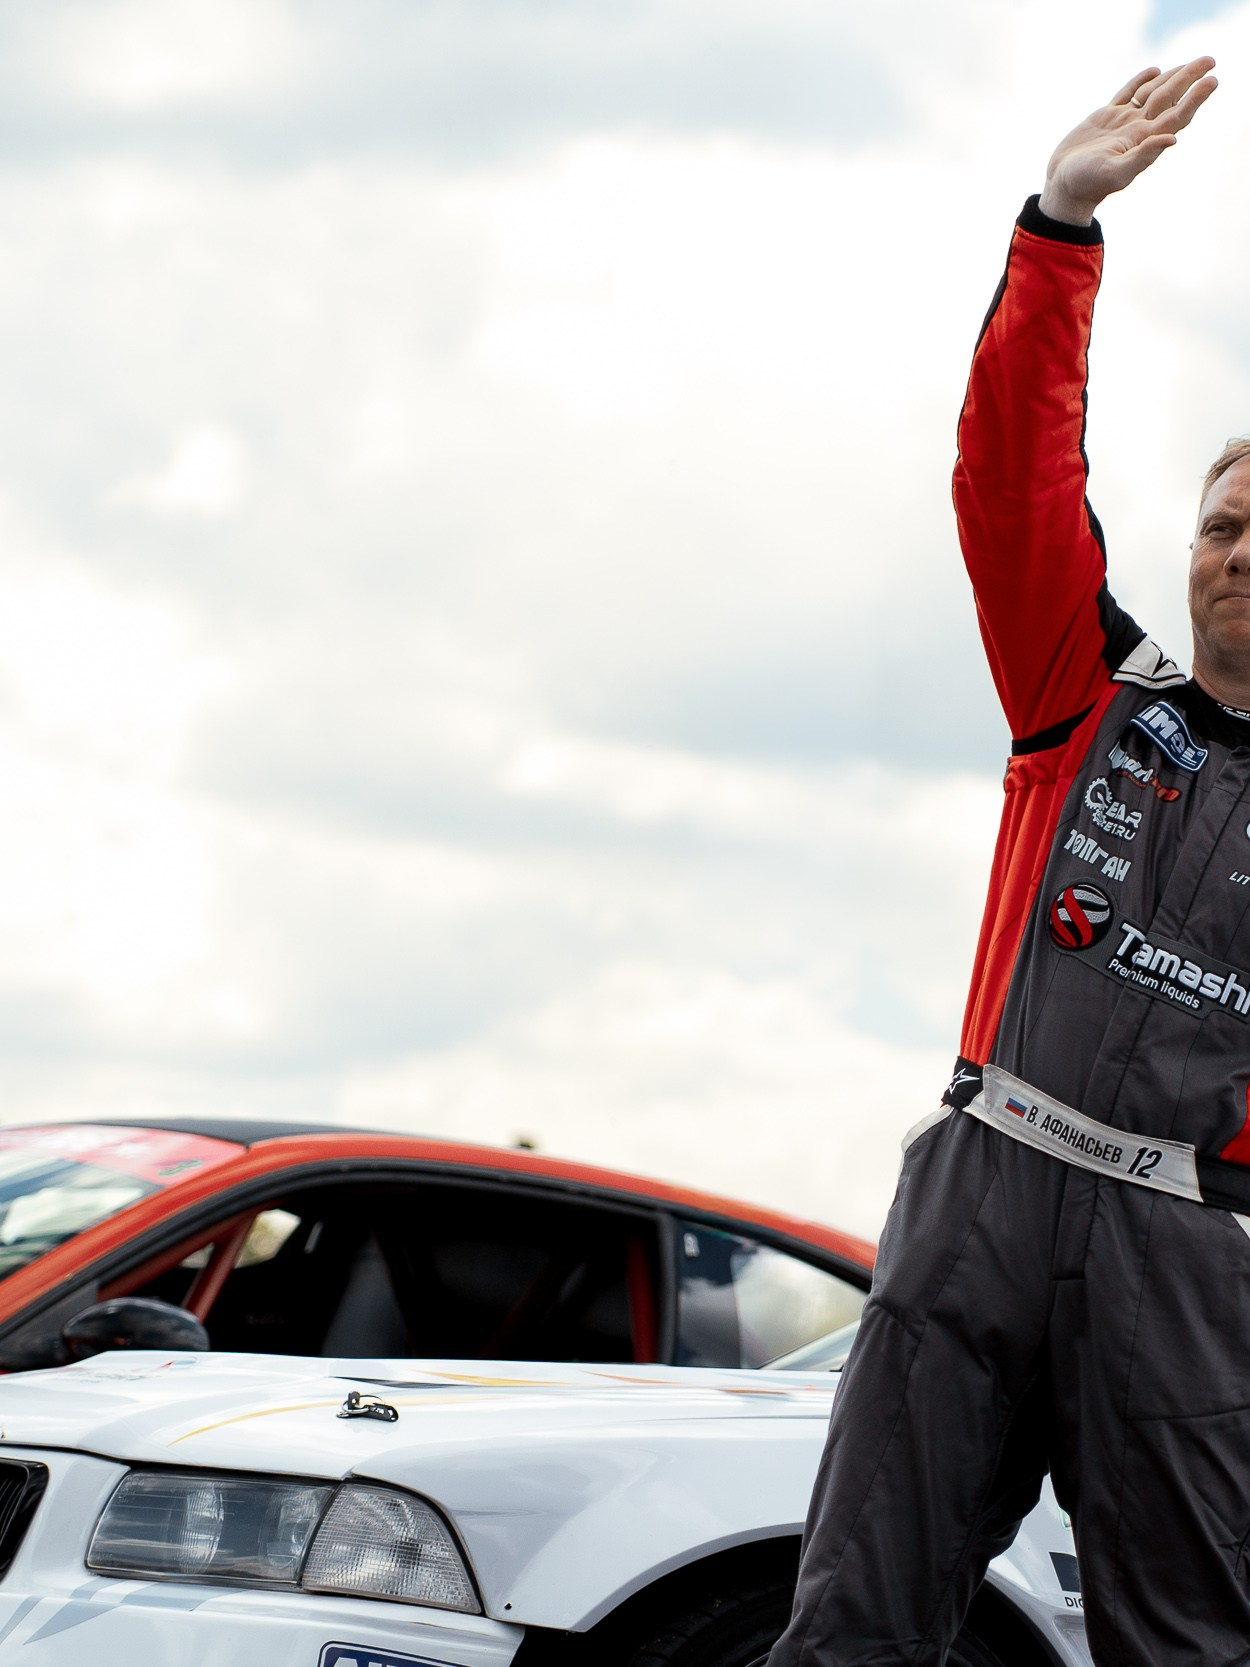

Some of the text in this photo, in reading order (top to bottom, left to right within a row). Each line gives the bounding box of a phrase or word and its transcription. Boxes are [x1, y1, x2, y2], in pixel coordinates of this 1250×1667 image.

[1137, 705, 1198, 767] IMOL
[1109, 958, 1200, 1009] Premium liquids
[1027, 1105, 1163, 1179] В. АФАНАСЬЕВ 12
